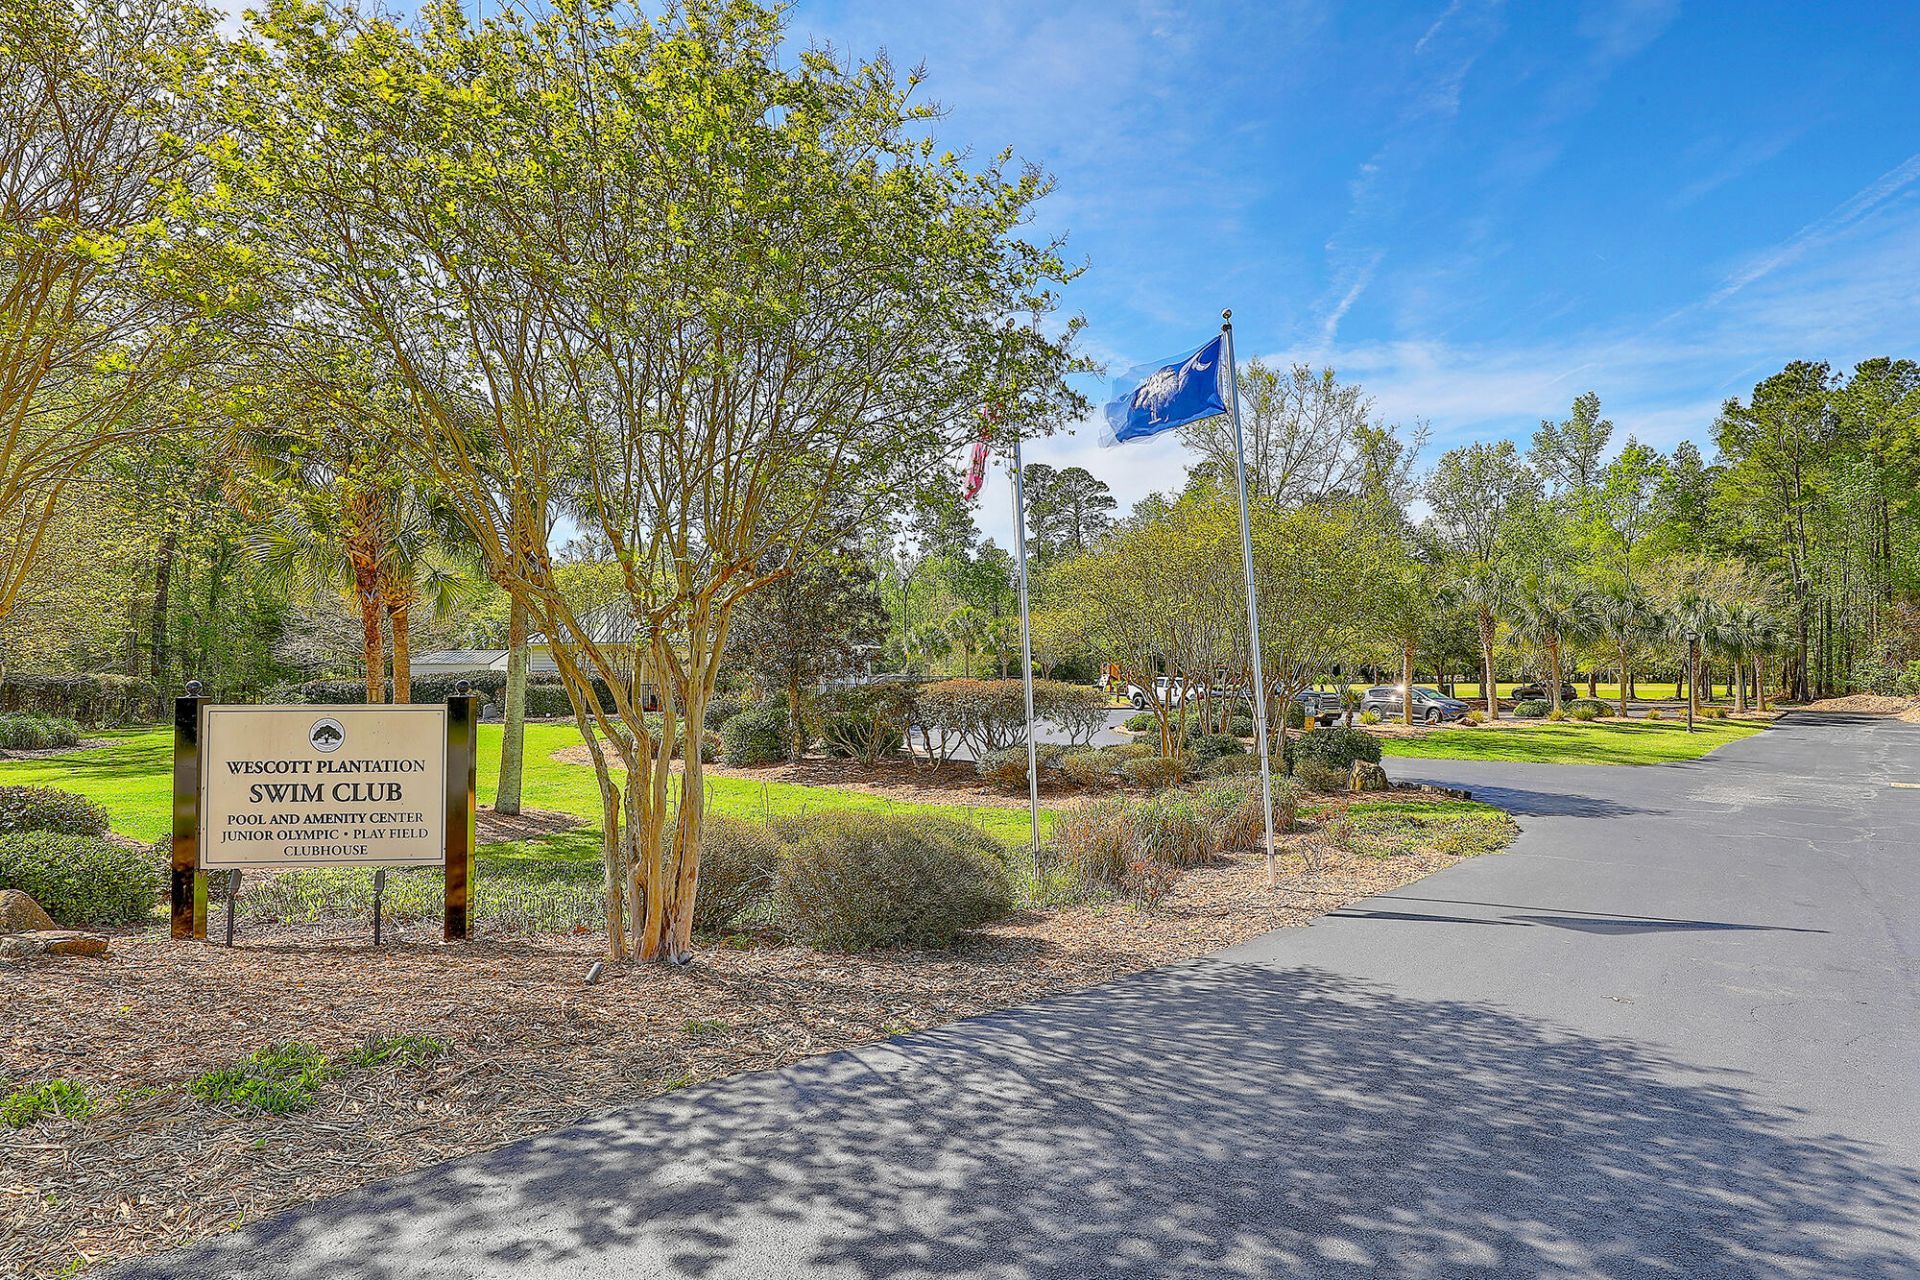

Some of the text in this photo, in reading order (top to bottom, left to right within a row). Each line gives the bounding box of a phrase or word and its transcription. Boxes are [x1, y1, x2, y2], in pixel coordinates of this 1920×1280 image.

[227, 760, 425, 774] WESCOTT PLANTATION
[249, 782, 403, 803] SWIM CLUB
[227, 812, 424, 826] POOL AND AMENITY CENTER
[221, 828, 428, 844] JUNIOR OLYMPIC PLAY FIELD
[283, 845, 368, 857] CLUBHOUSE
